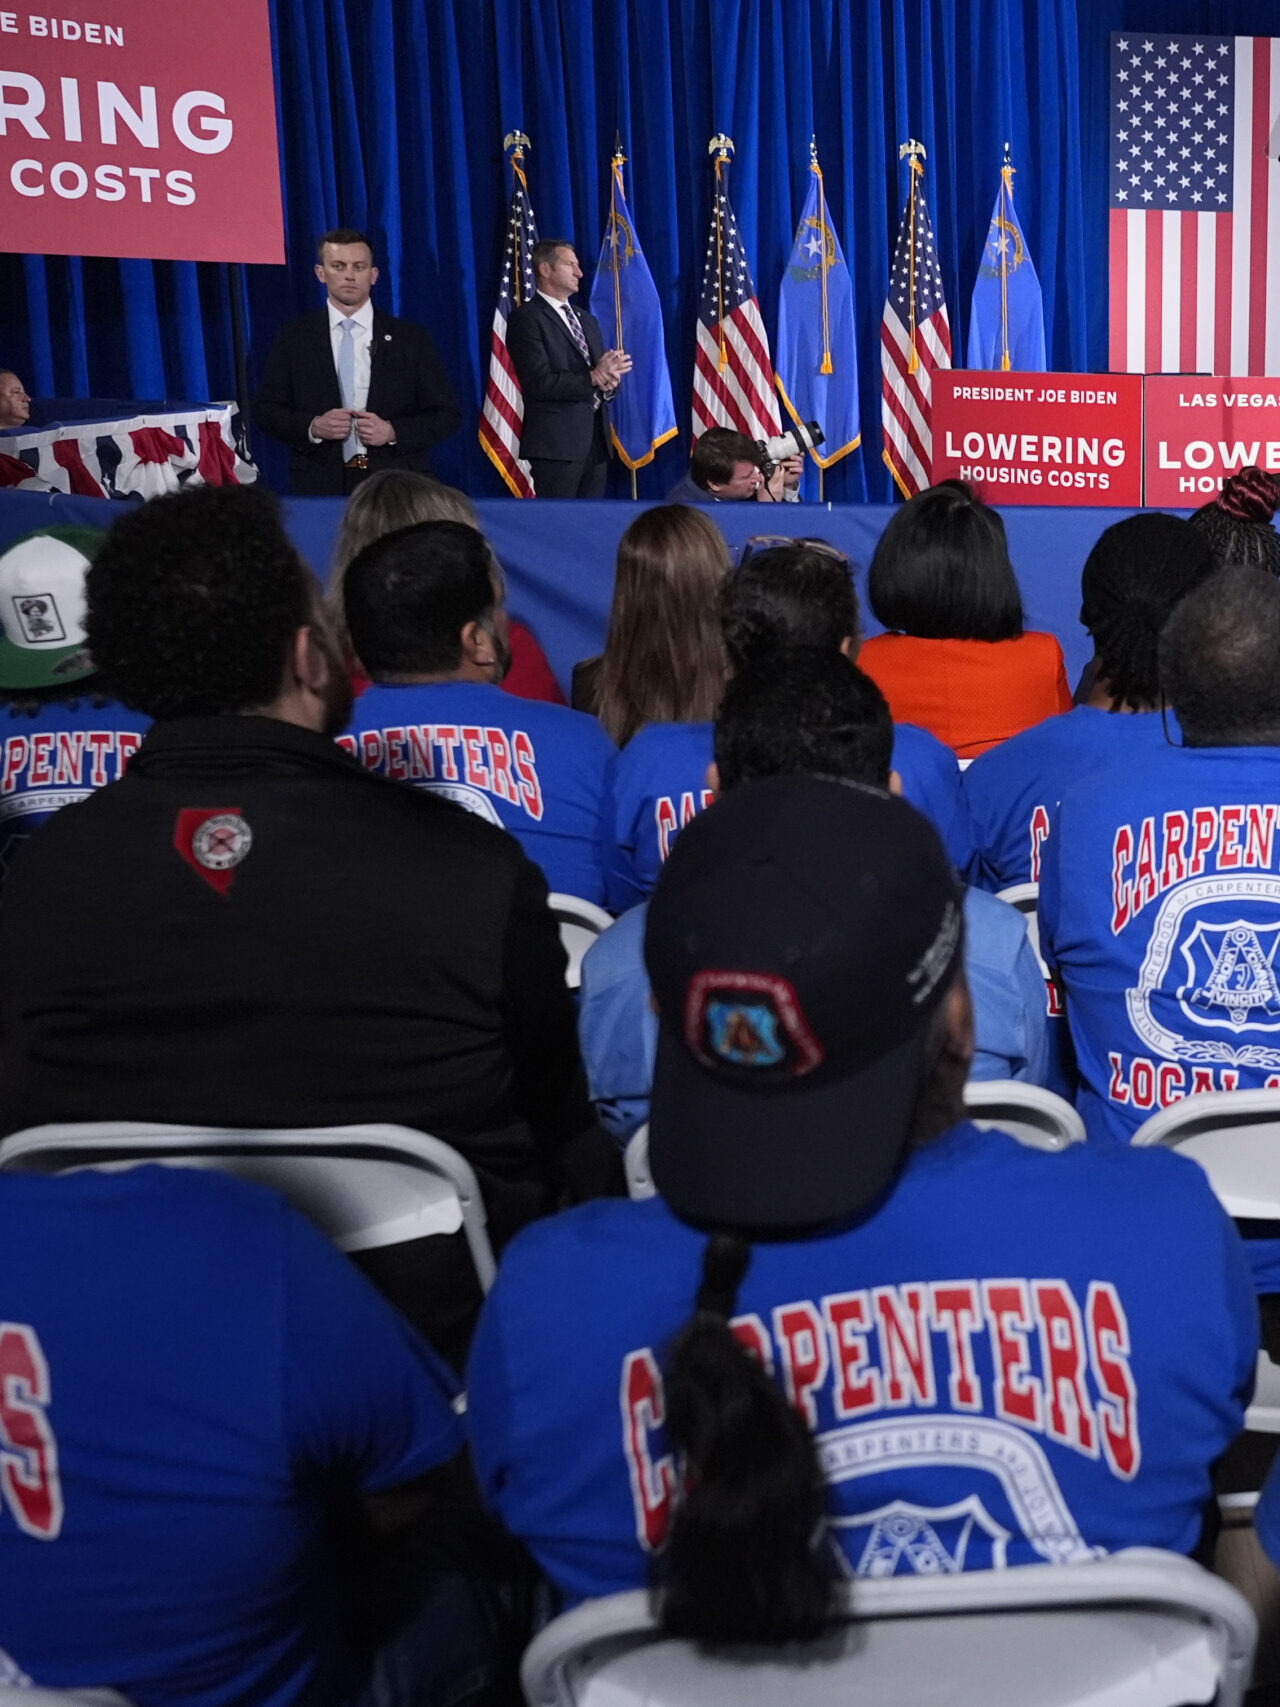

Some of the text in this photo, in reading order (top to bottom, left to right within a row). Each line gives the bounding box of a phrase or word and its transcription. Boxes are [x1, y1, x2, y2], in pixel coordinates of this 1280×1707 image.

[29, 15, 125, 47] BIDEN
[10, 158, 197, 206] COSTS
[953, 386, 1117, 405] PRESIDENT JOE BIDEN
[1178, 393, 1218, 407] LAS
[945, 431, 1126, 467] LOWERING
[960, 465, 1110, 490] HOUSING COSTS
[620, 1278, 1142, 1553] CPENTERS
[824, 1430, 981, 1469] ARPENTERS
